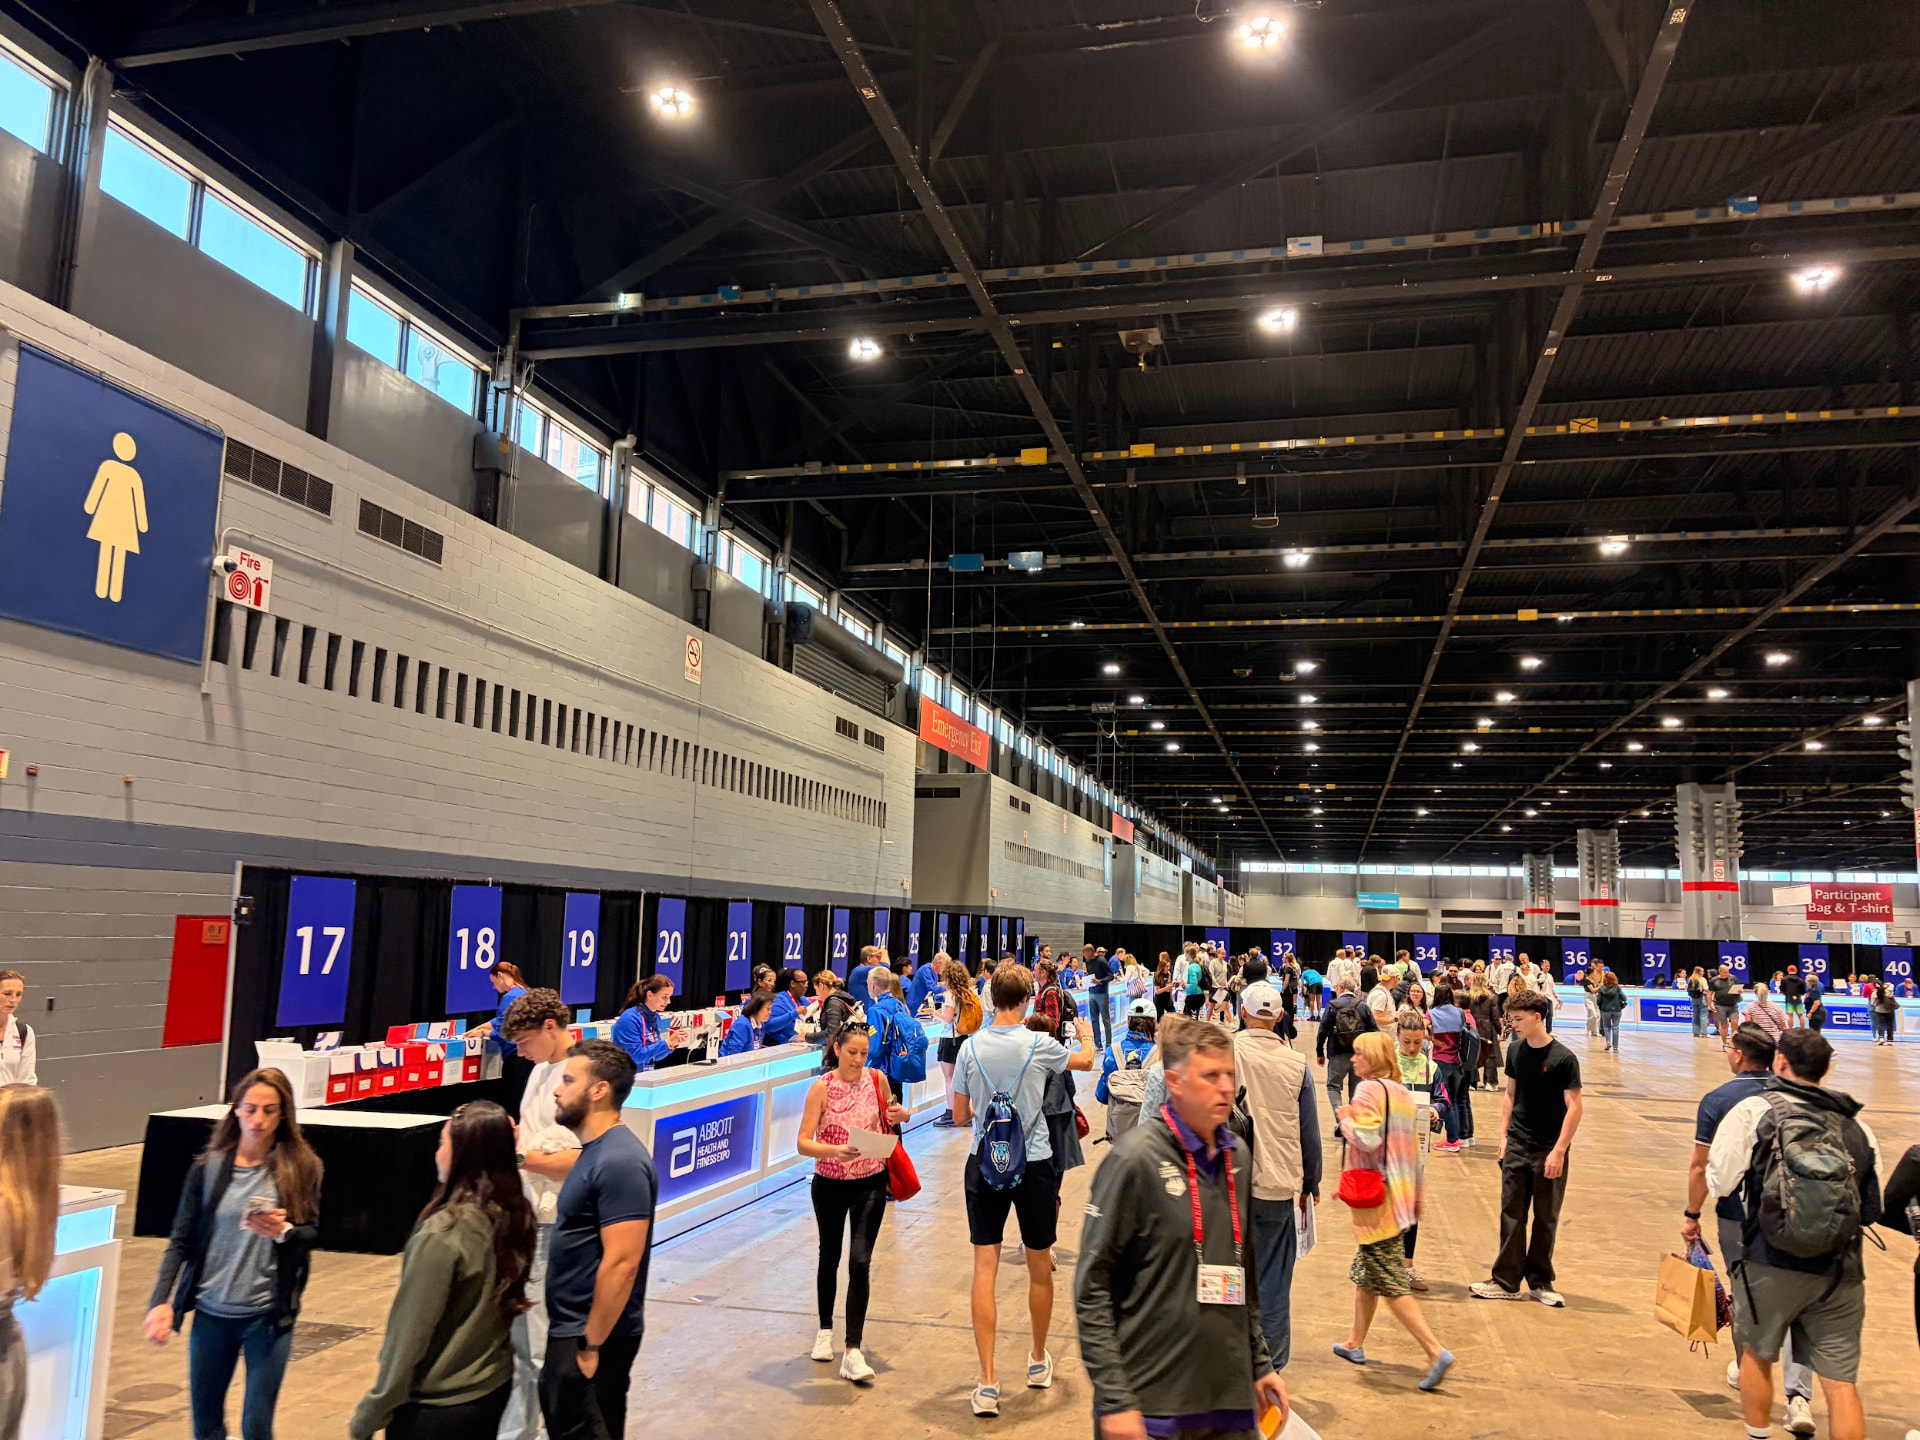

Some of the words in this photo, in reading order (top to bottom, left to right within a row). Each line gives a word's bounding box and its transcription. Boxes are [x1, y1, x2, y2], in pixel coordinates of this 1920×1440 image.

[240, 552, 261, 571] Fire
[932, 709, 969, 754] Emergency
[970, 731, 982, 756] Exit
[1815, 889, 1882, 902] Participant
[1808, 902, 1831, 915] Bag
[1835, 902, 1845, 913] &
[1849, 902, 1891, 914] T-shirt
[456, 927, 496, 970] 18
[568, 930, 595, 967] 19
[658, 930, 682, 963] 20
[728, 931, 747, 961] 21
[785, 933, 801, 959] 22
[833, 933, 848, 958] 23
[875, 932, 887, 950] 24
[909, 933, 920, 954] 25
[939, 933, 948, 952] 26
[960, 934, 968, 952] 27
[980, 934, 988, 952] 28
[1273, 942, 1293, 956] 32
[297, 926, 345, 975] 17
[1415, 947, 1437, 960] 34
[1564, 951, 1588, 966] 36
[1644, 953, 1667, 967] 37
[1721, 955, 1747, 970] 38
[1802, 958, 1827, 973] 39
[1885, 961, 1911, 976] 40
[709, 1036, 719, 1048] 17
[698, 1117, 734, 1142] ABBOTT
[698, 1142, 717, 1157] HEALTH
[717, 1139, 728, 1150] AND
[696, 1153, 717, 1170] FITNESS
[716, 1149, 730, 1162] EXPO
